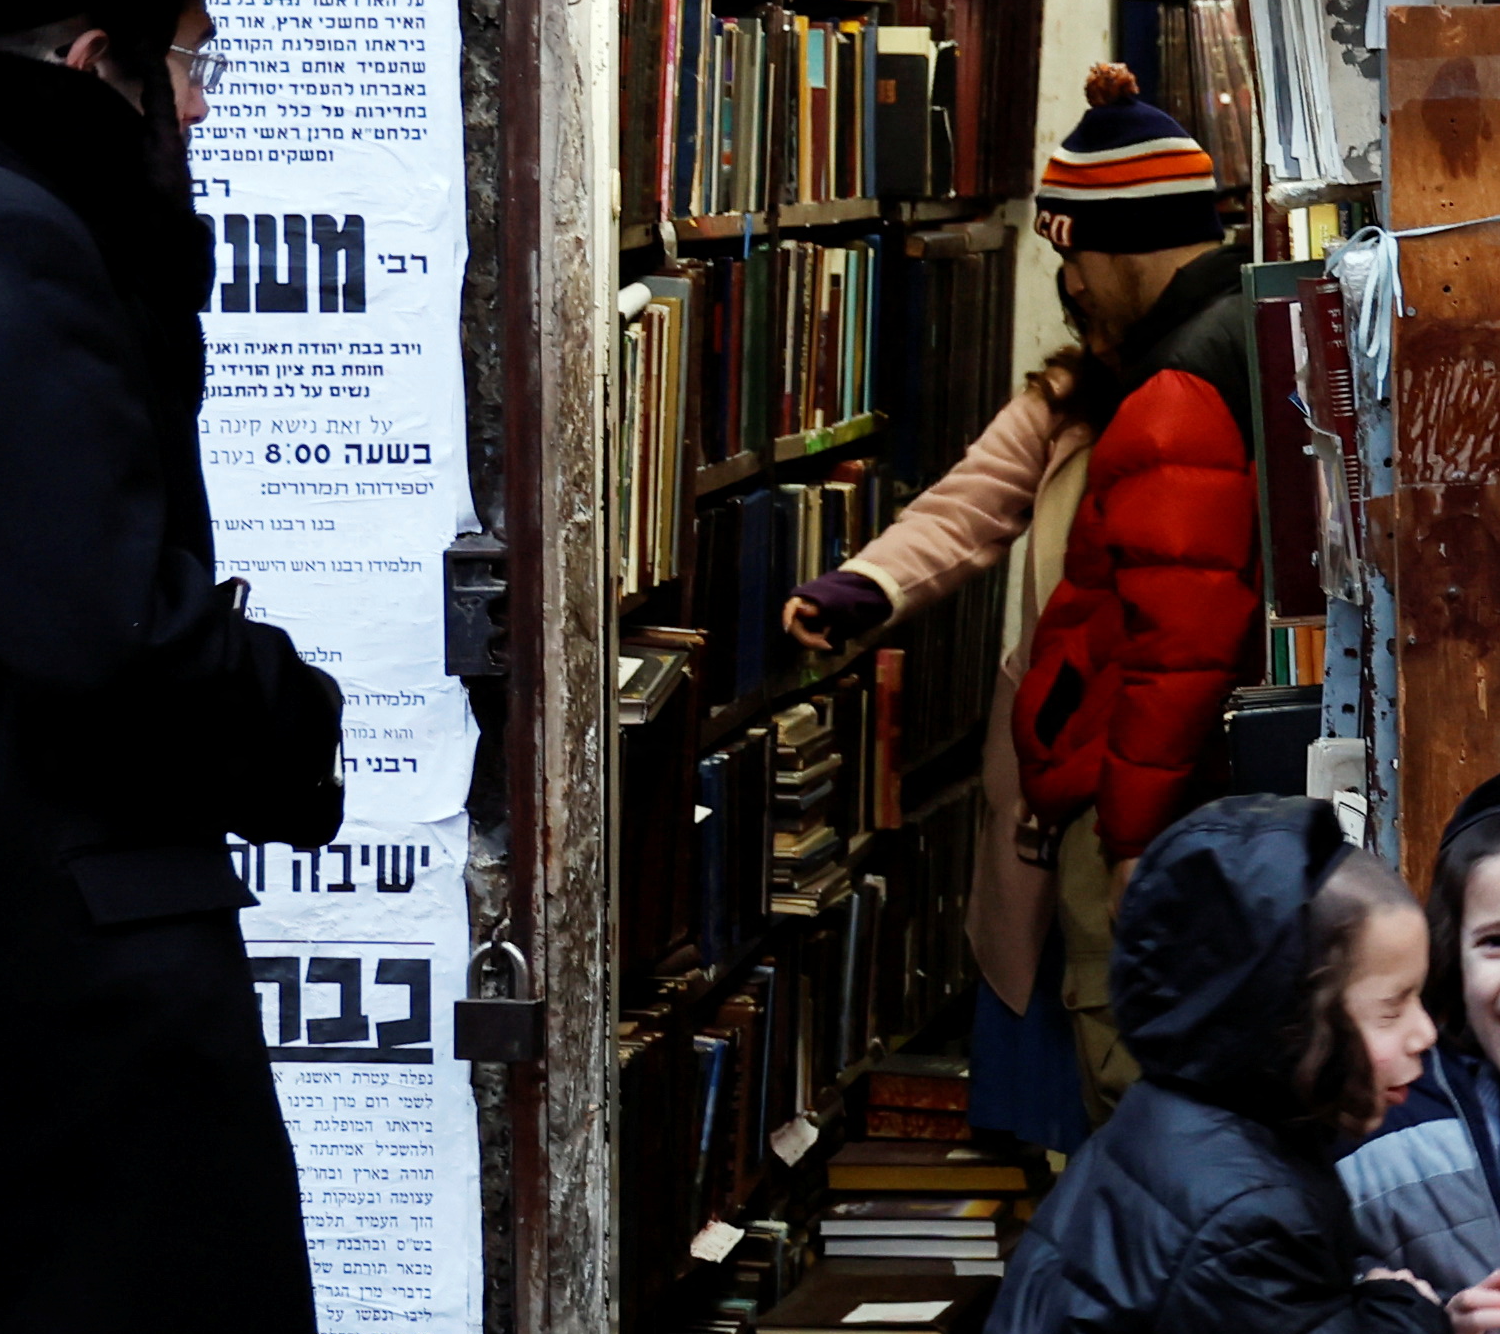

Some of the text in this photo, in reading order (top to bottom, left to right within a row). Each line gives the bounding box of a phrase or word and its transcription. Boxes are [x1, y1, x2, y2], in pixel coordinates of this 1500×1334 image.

[235, 16, 265, 29] אור
[318, 17, 379, 29] מחשכי
[384, 16, 425, 29] האיר
[229, 82, 427, 96] באברתו להעמיד יסודות
[377, 253, 428, 274] רבי
[273, 383, 370, 399] נשים על לב
[209, 442, 433, 466] בשעה 8:00 בערב
[366, 757, 417, 773] רבני
[291, 842, 431, 894] ישיבה
